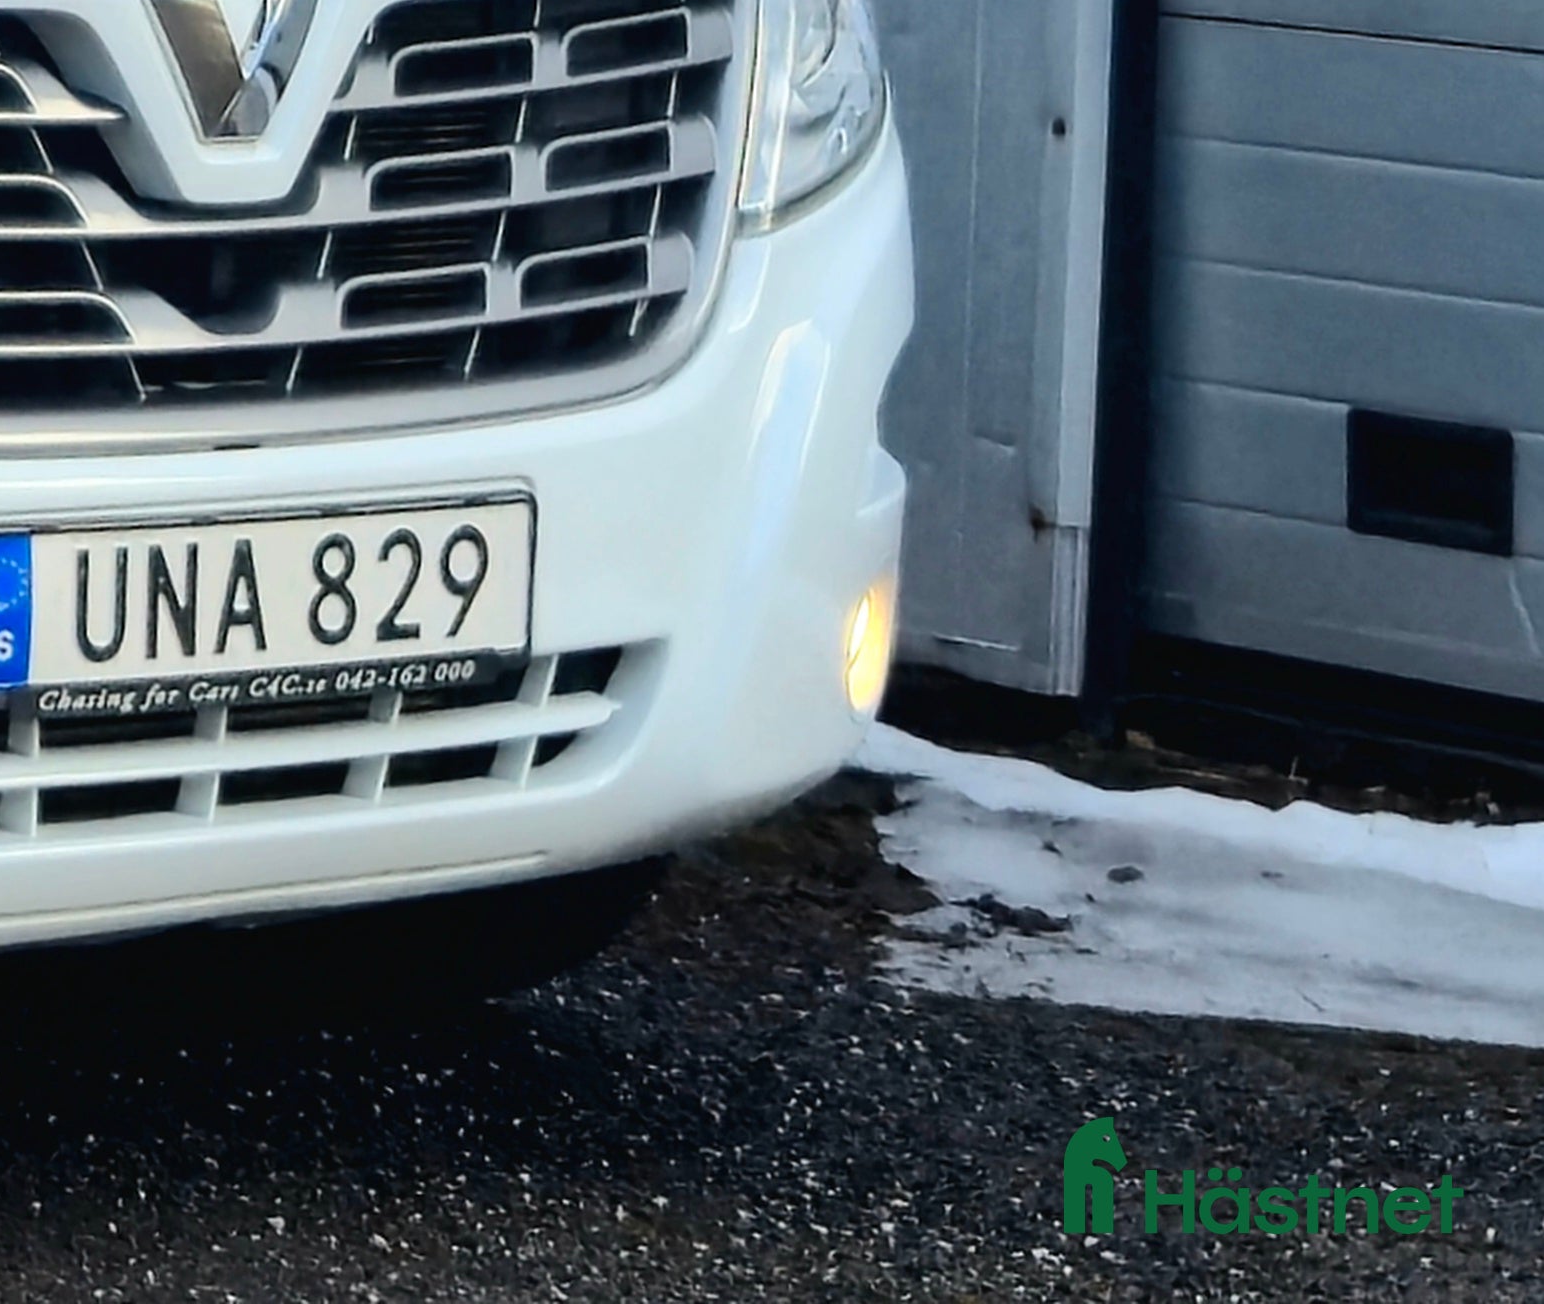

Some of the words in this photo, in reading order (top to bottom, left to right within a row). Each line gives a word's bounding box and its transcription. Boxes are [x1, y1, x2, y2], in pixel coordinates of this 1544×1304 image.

[76, 539, 268, 662] UNA
[308, 524, 489, 645] 829
[38, 688, 134, 714] Chasing
[139, 682, 179, 712] for
[335, 661, 429, 692] 042-162
[434, 658, 476, 682] 000
